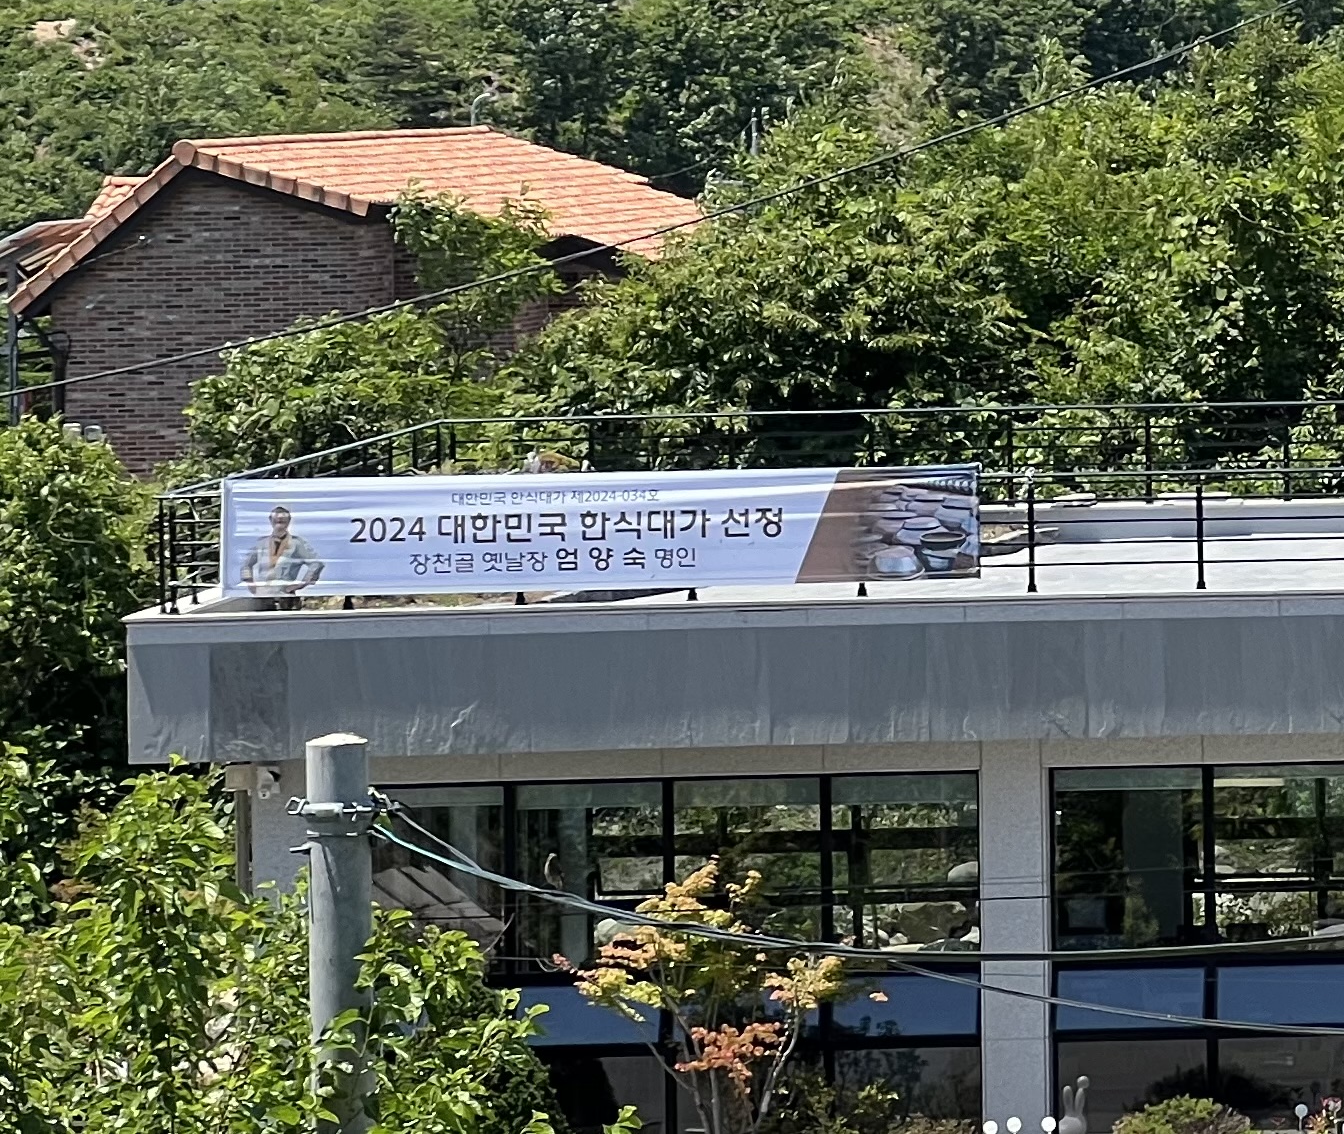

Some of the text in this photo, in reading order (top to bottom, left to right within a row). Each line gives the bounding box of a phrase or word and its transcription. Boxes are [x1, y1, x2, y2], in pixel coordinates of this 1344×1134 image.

[451, 491, 507, 506] 대한민국
[510, 490, 566, 505] 한식대가
[349, 507, 783, 543] 2024 대한민국 한식대가 선정
[409, 553, 475, 575] 장천골
[482, 551, 548, 572] 옛날장
[654, 547, 697, 569] 명인
